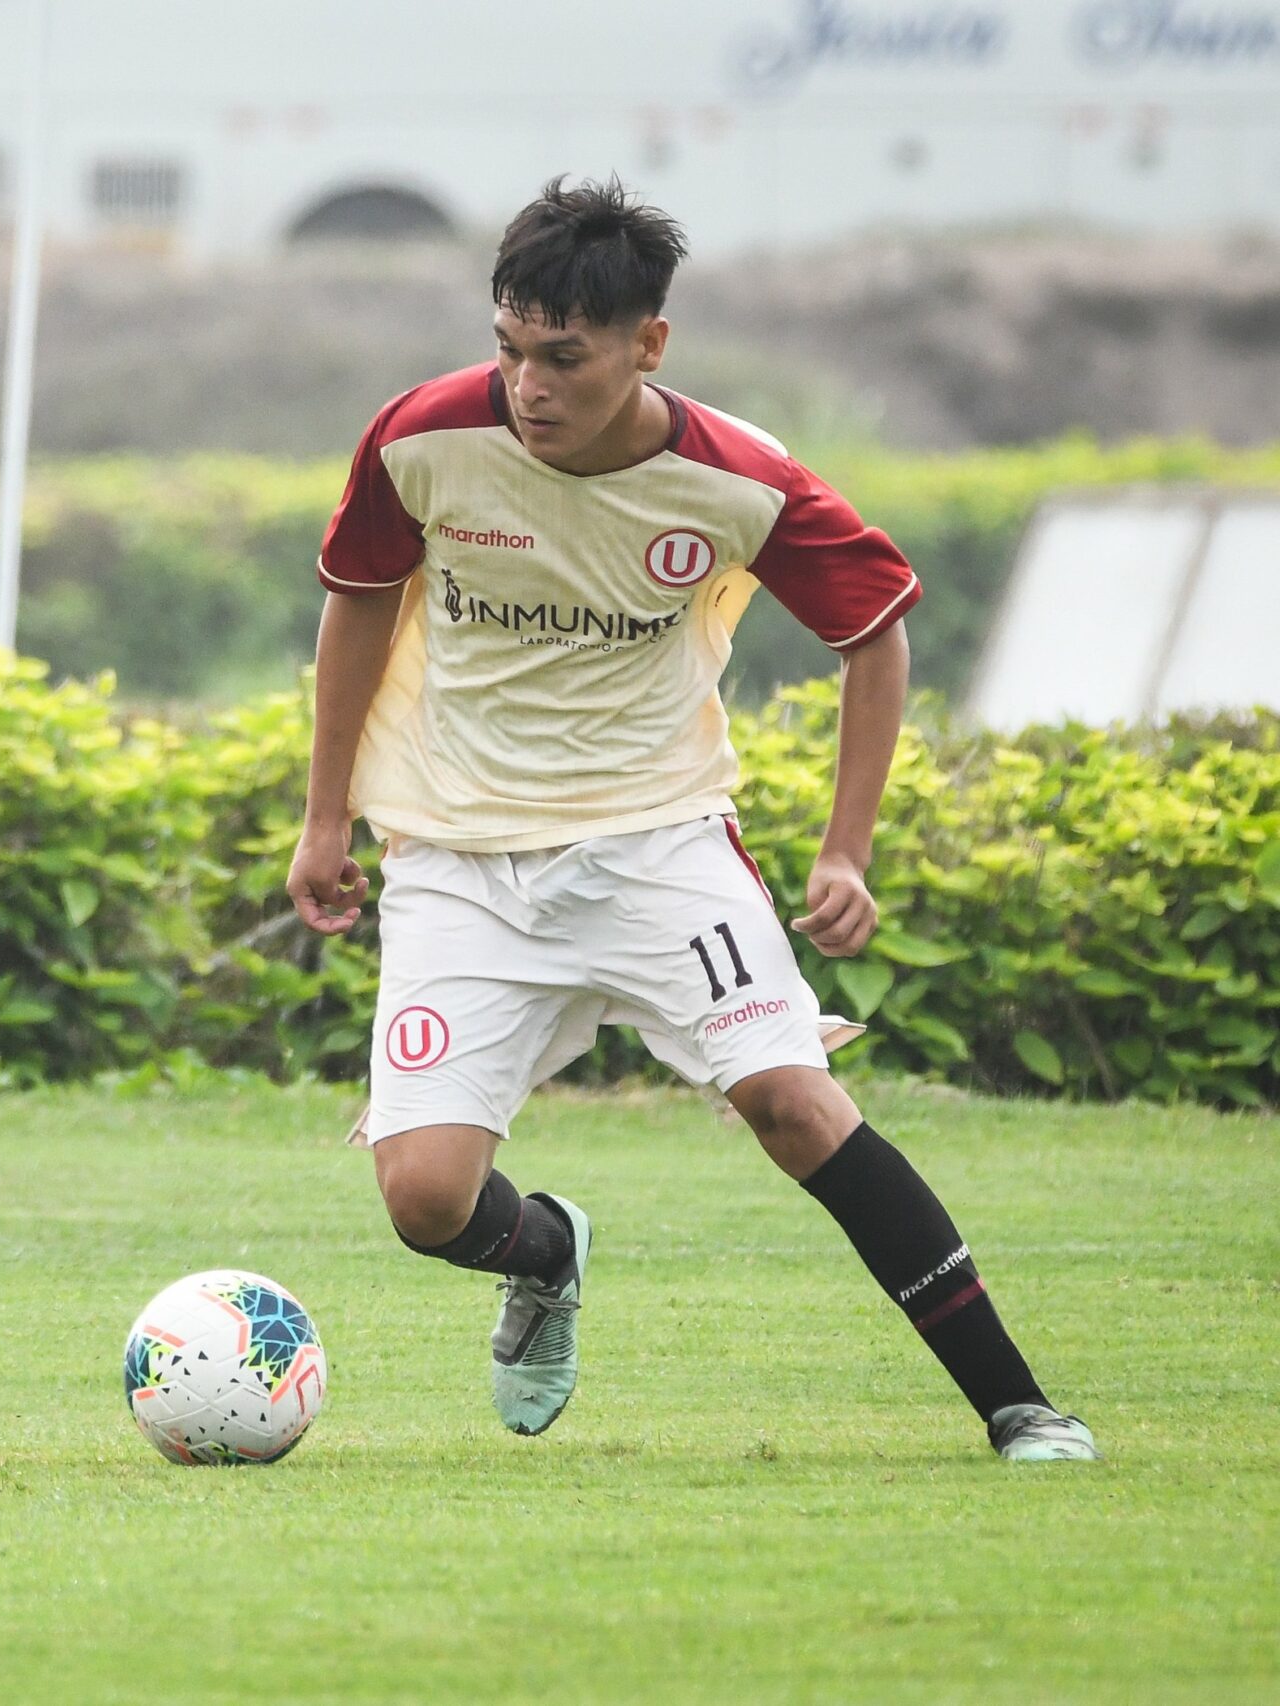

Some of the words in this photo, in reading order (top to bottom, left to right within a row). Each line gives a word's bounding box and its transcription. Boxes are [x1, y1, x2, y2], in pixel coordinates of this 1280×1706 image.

[439, 523, 535, 549] marathon
[663, 540, 699, 578] U
[689, 921, 754, 1003] 11
[705, 999, 790, 1039] marathon
[399, 1018, 431, 1062] U
